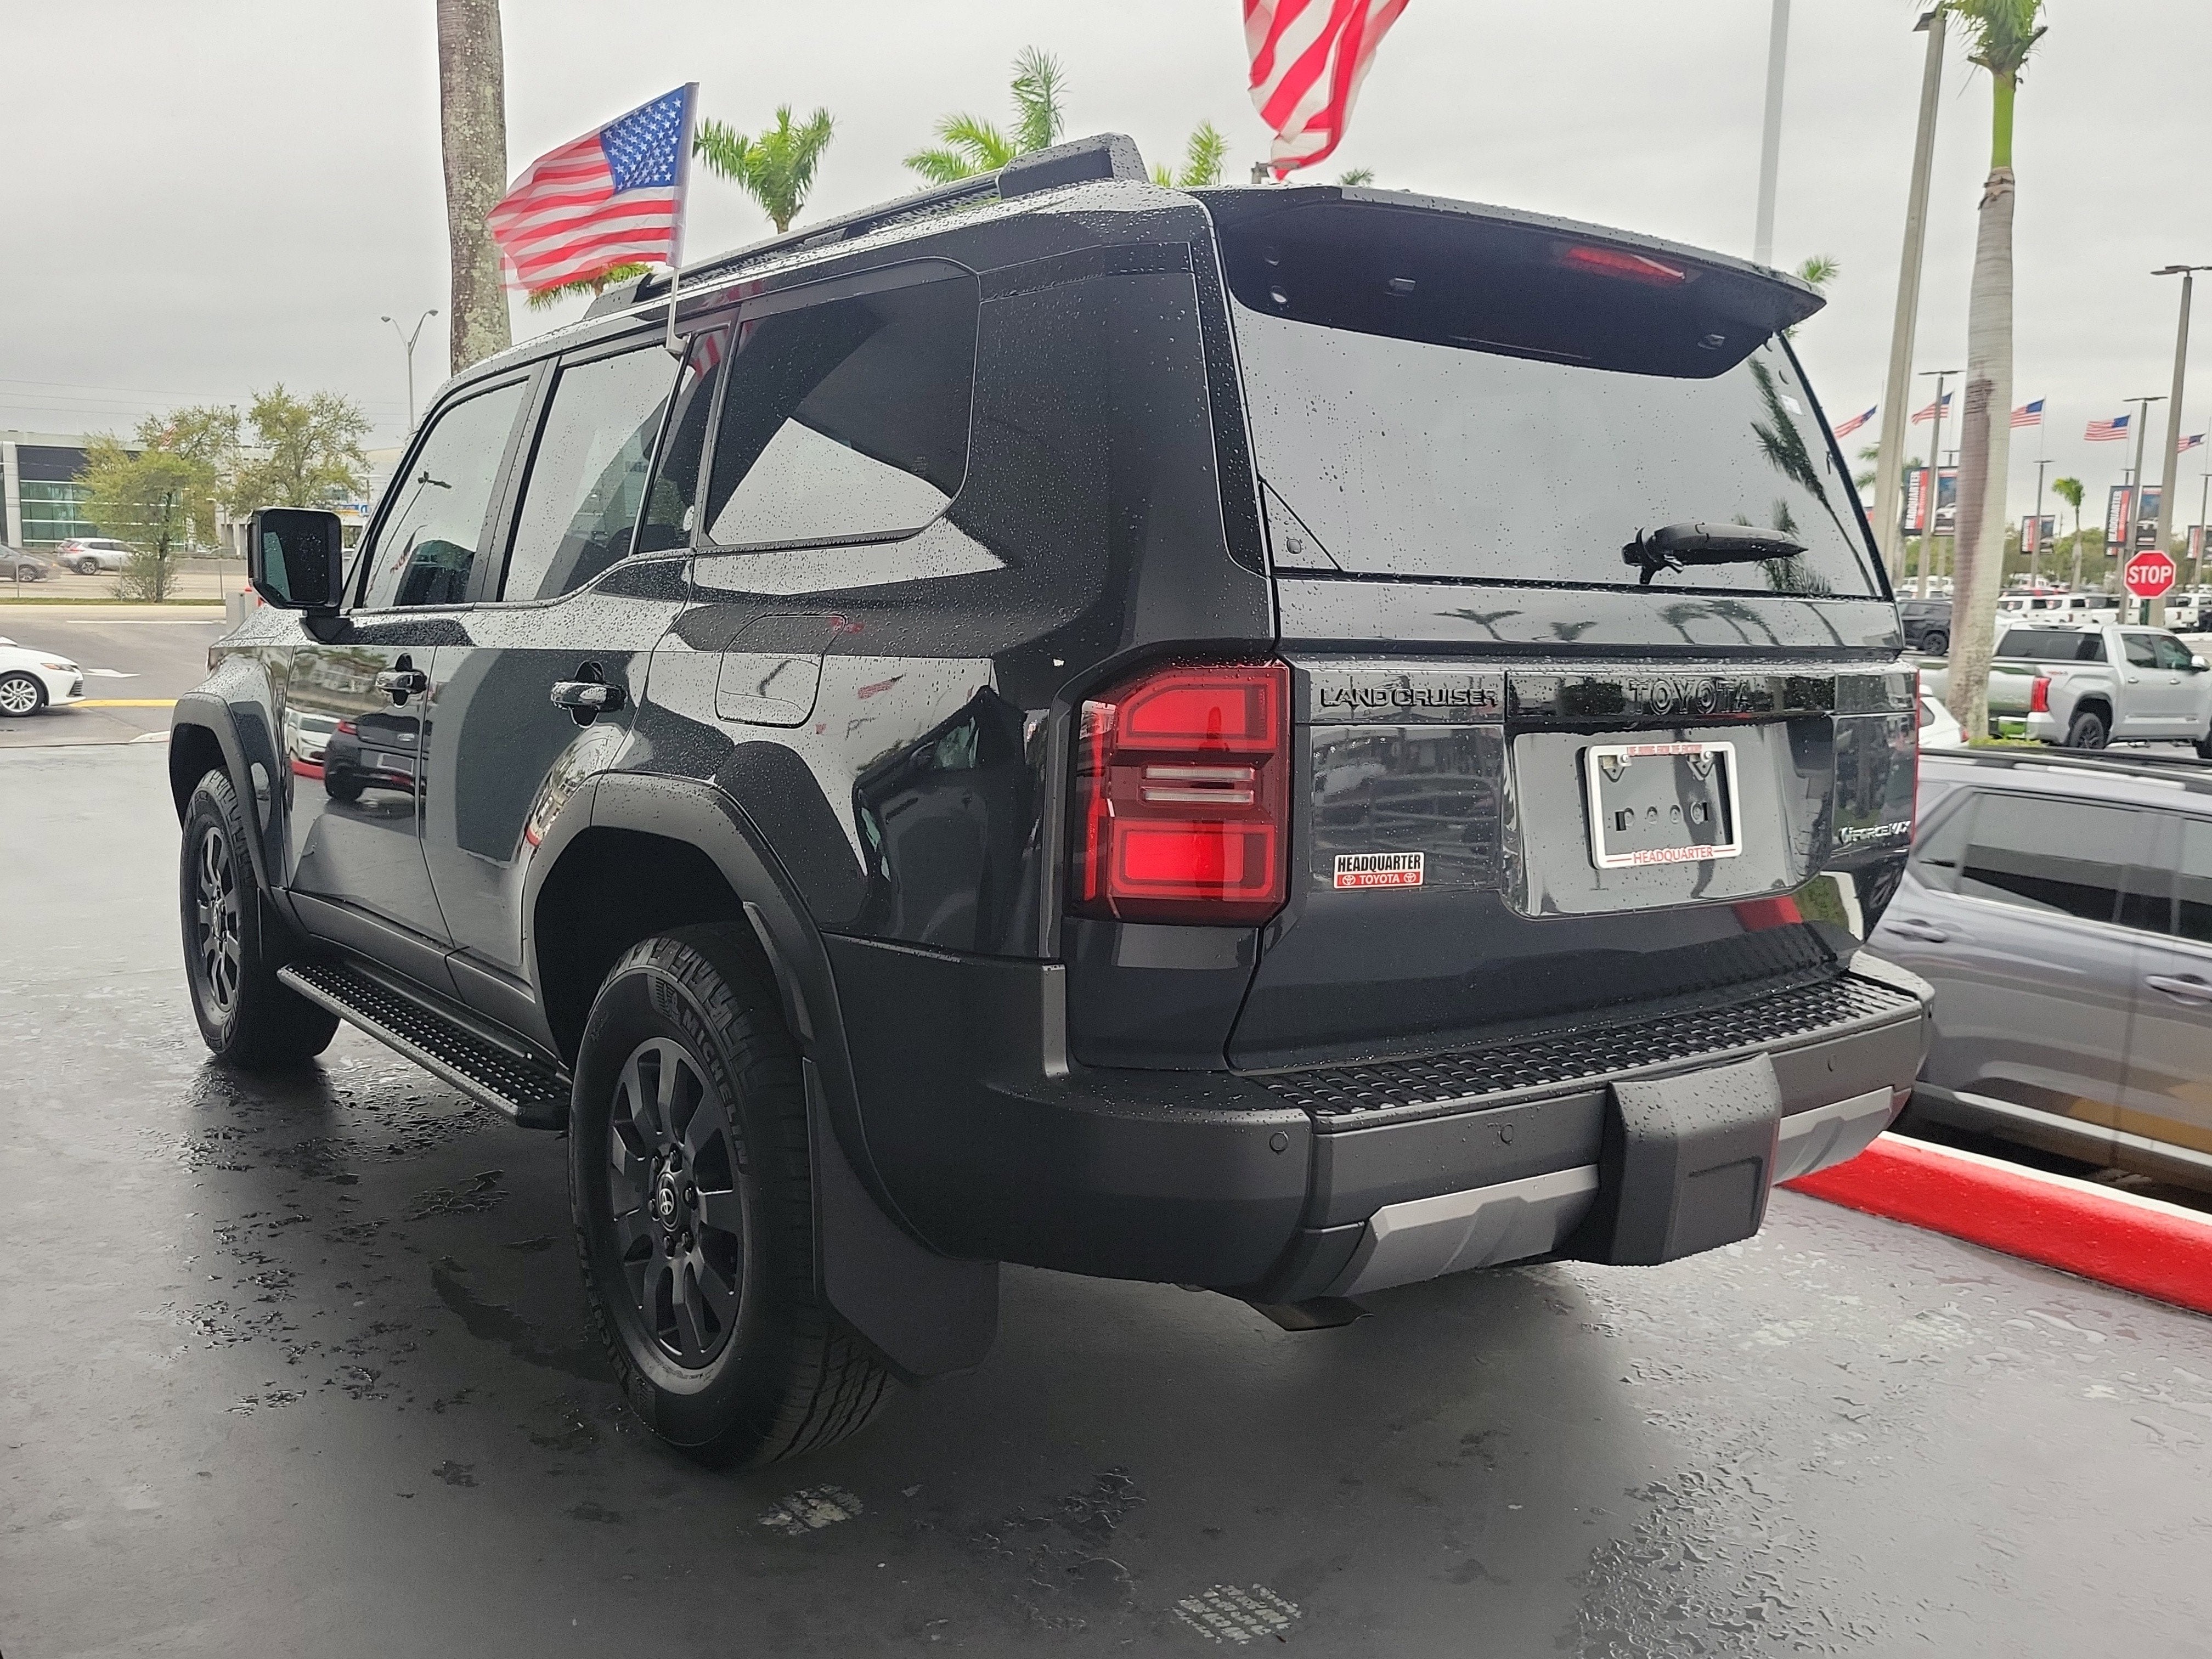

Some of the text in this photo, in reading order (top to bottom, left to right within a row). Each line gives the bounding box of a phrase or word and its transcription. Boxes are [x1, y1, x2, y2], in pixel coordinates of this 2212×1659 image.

[2128, 565, 2172, 584] STOP
[1321, 688, 1498, 708] LAND CRUISER
[1628, 678, 1754, 715] TOYOTA
[1337, 854, 1421, 872] HEADQUARTER
[1633, 847, 1713, 864] HEADQUARTER
[1359, 874, 1400, 884] TOYOTA
[682, 1009, 748, 1165] MICHELIN
